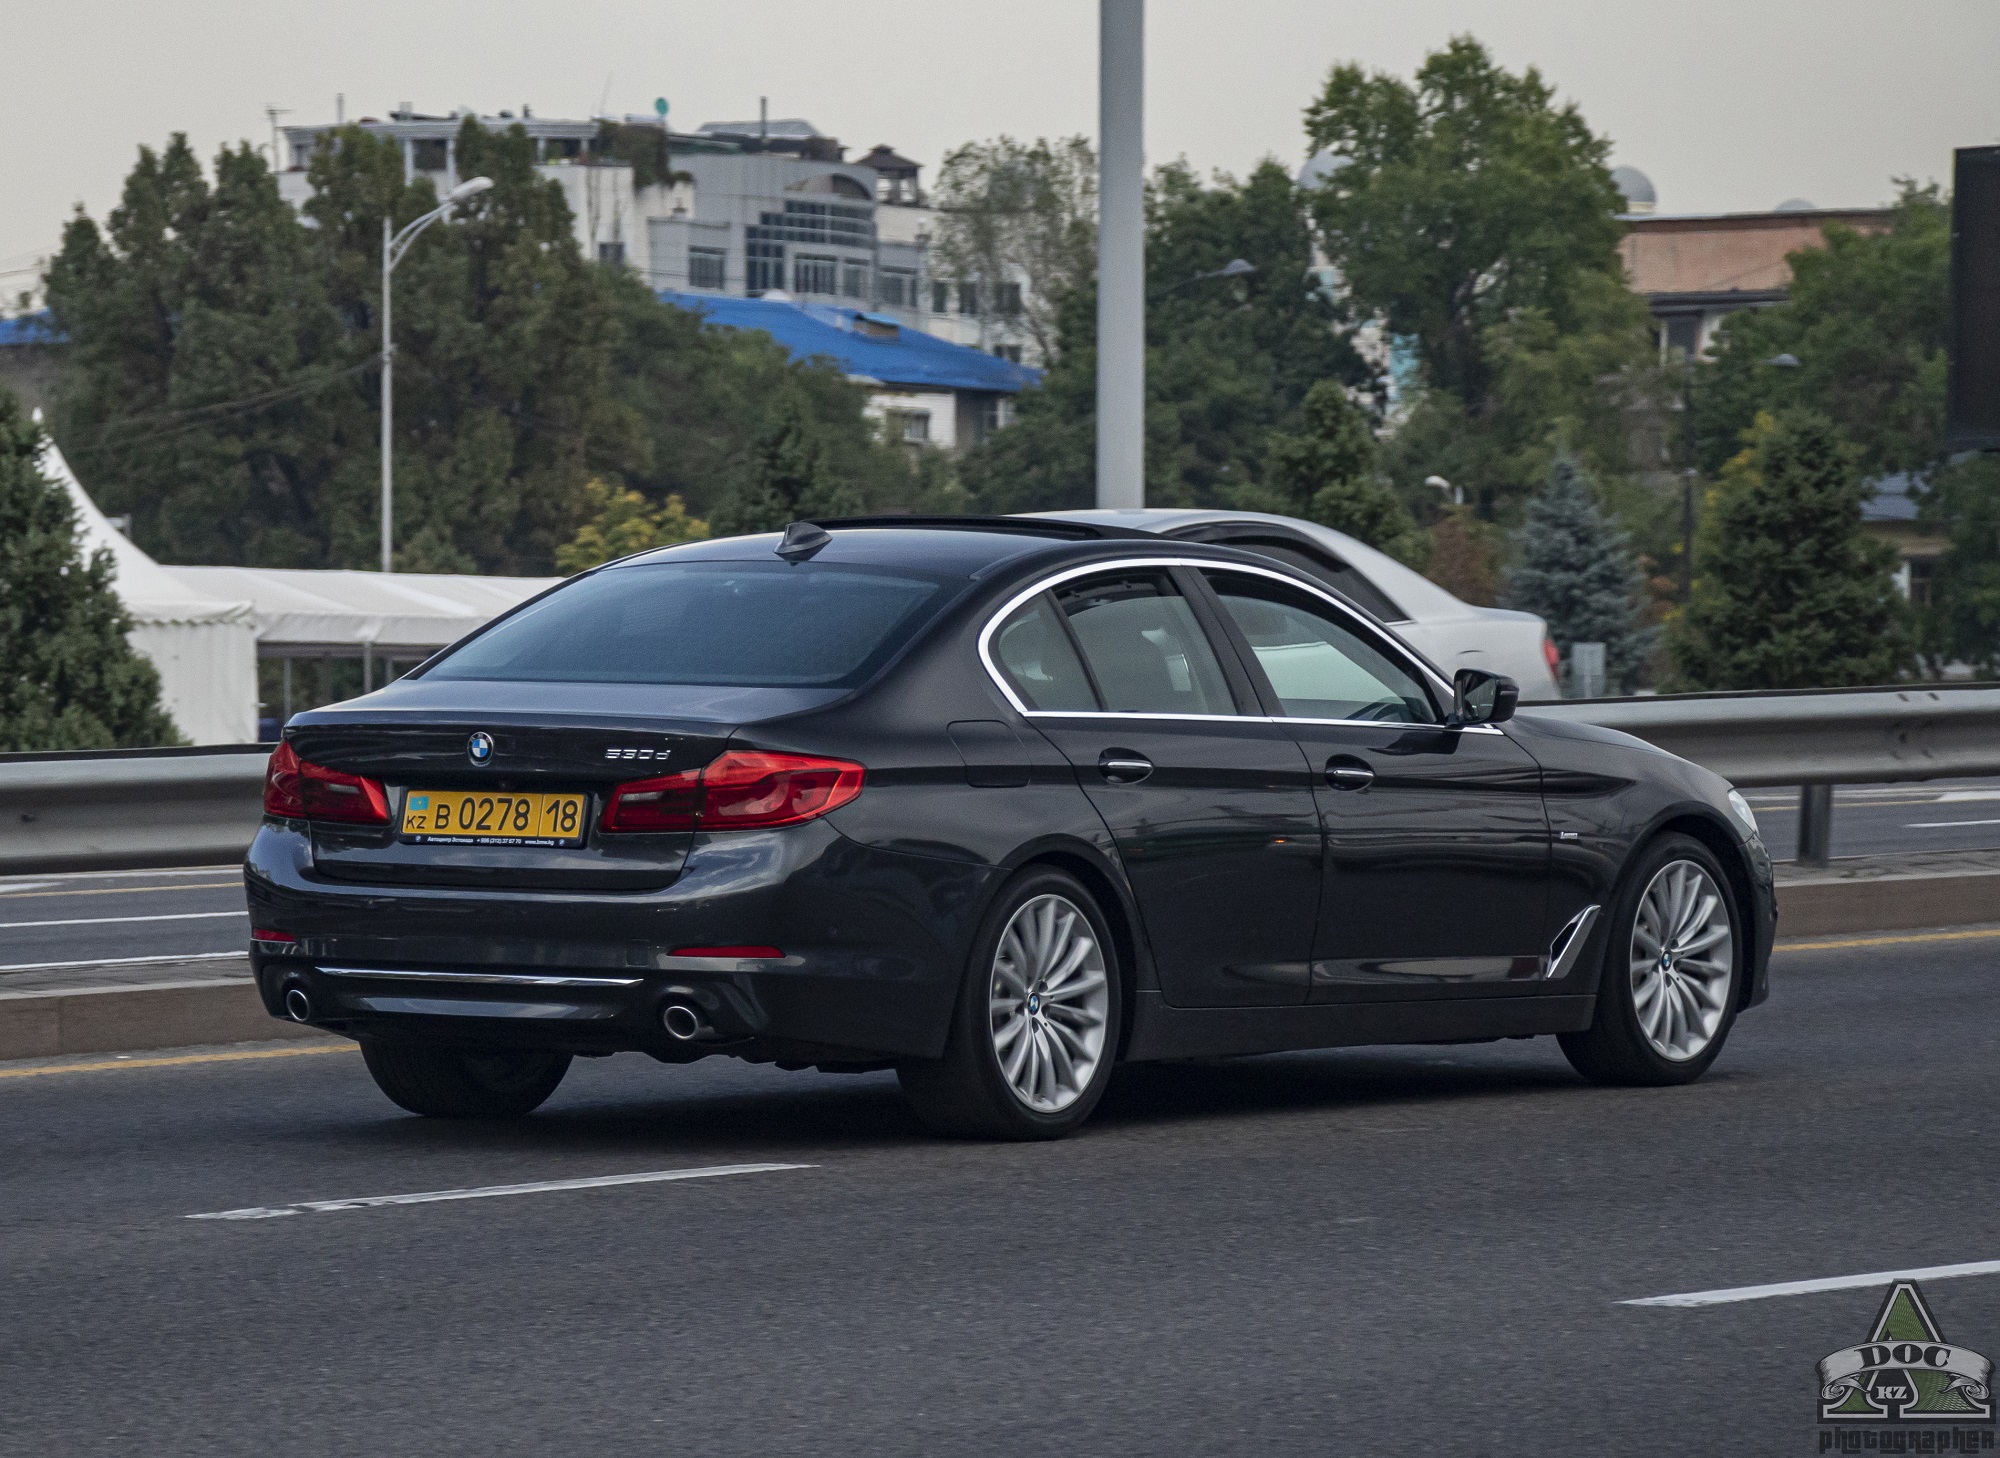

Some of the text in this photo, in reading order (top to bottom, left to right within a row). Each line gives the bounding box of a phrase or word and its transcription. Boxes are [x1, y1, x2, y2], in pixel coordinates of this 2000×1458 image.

[405, 815, 427, 830] KZ
[434, 797, 579, 833] B 0278 18
